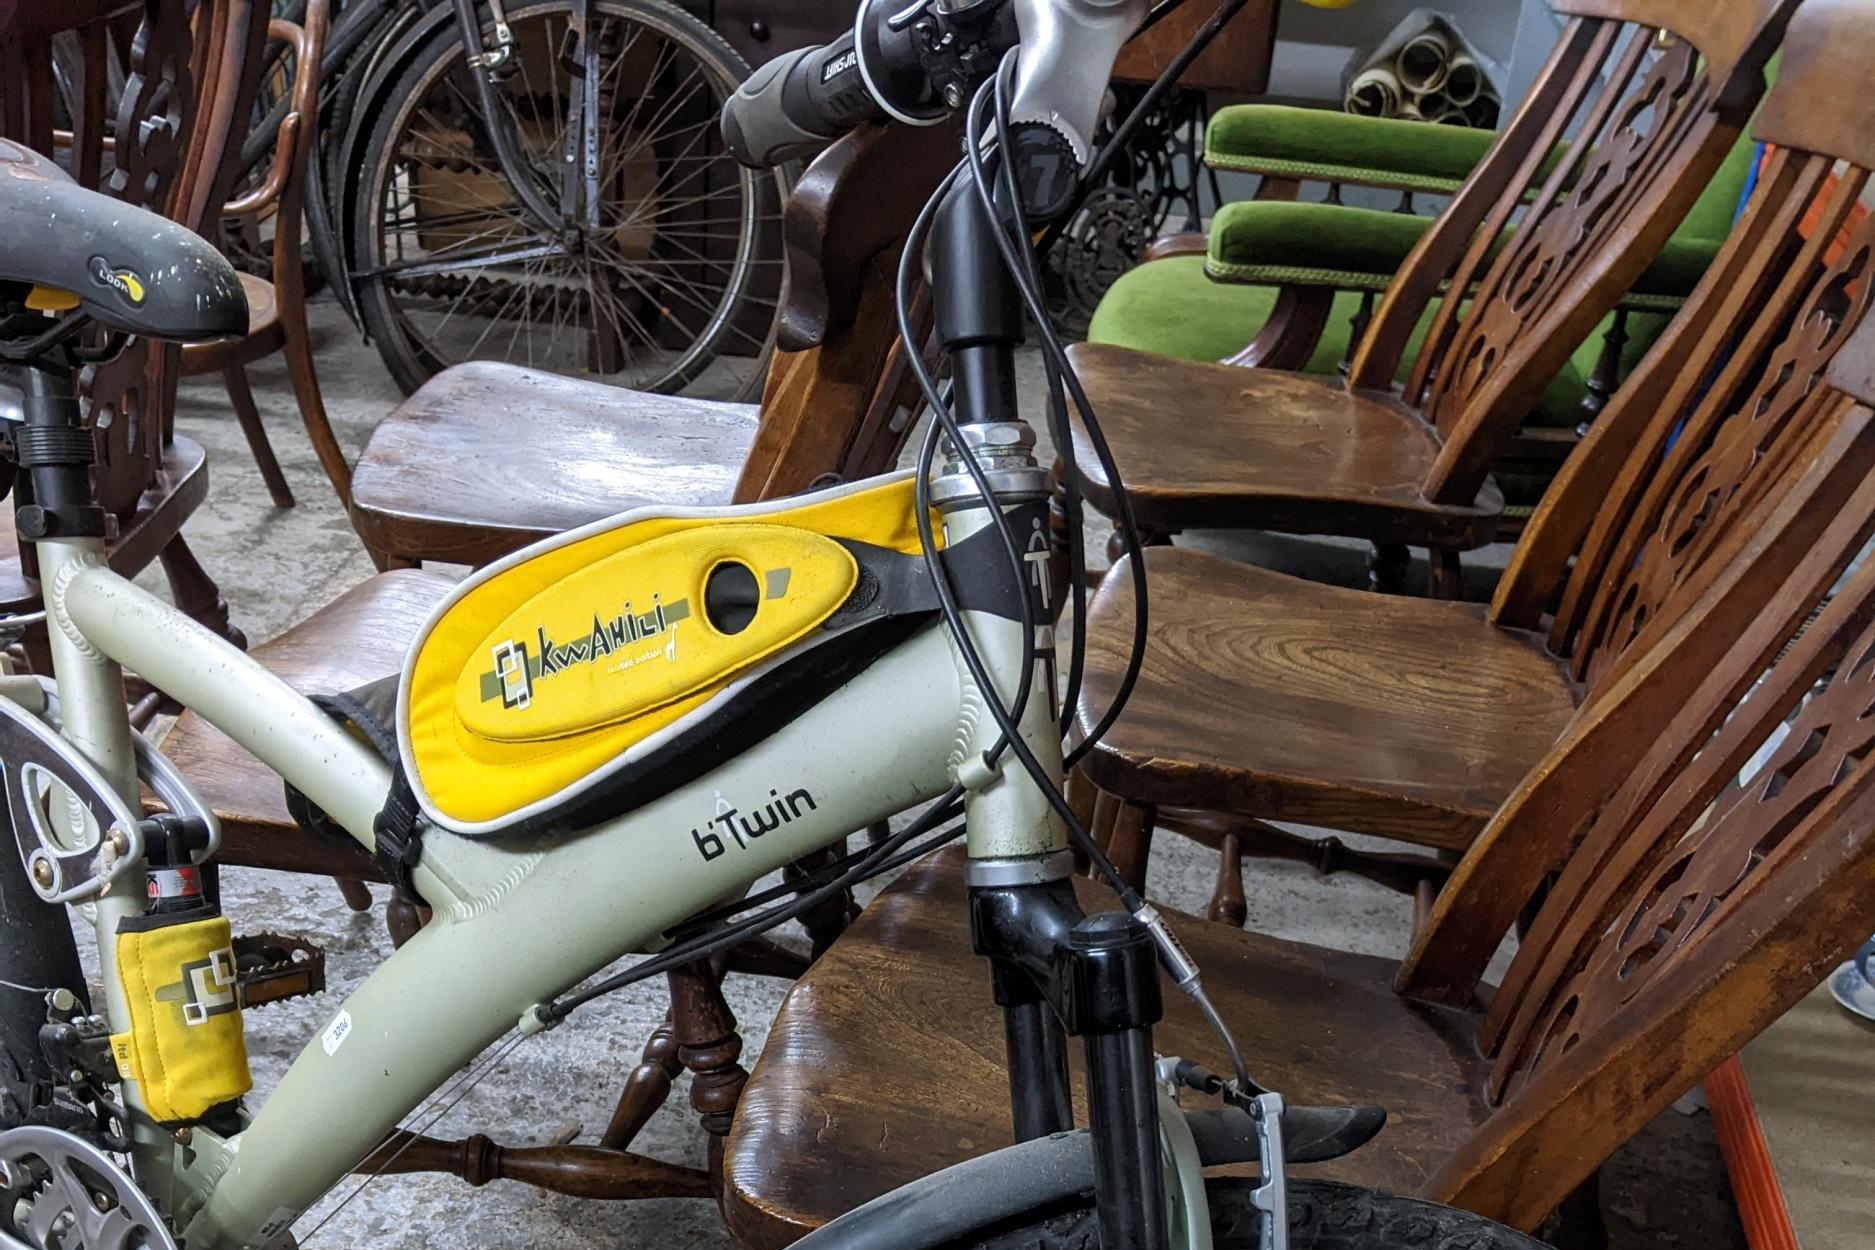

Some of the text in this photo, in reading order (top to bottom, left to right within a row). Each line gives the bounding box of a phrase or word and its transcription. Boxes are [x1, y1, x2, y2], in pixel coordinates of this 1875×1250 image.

[99, 269, 129, 293] LOOK
[607, 648, 663, 675] limited edition
